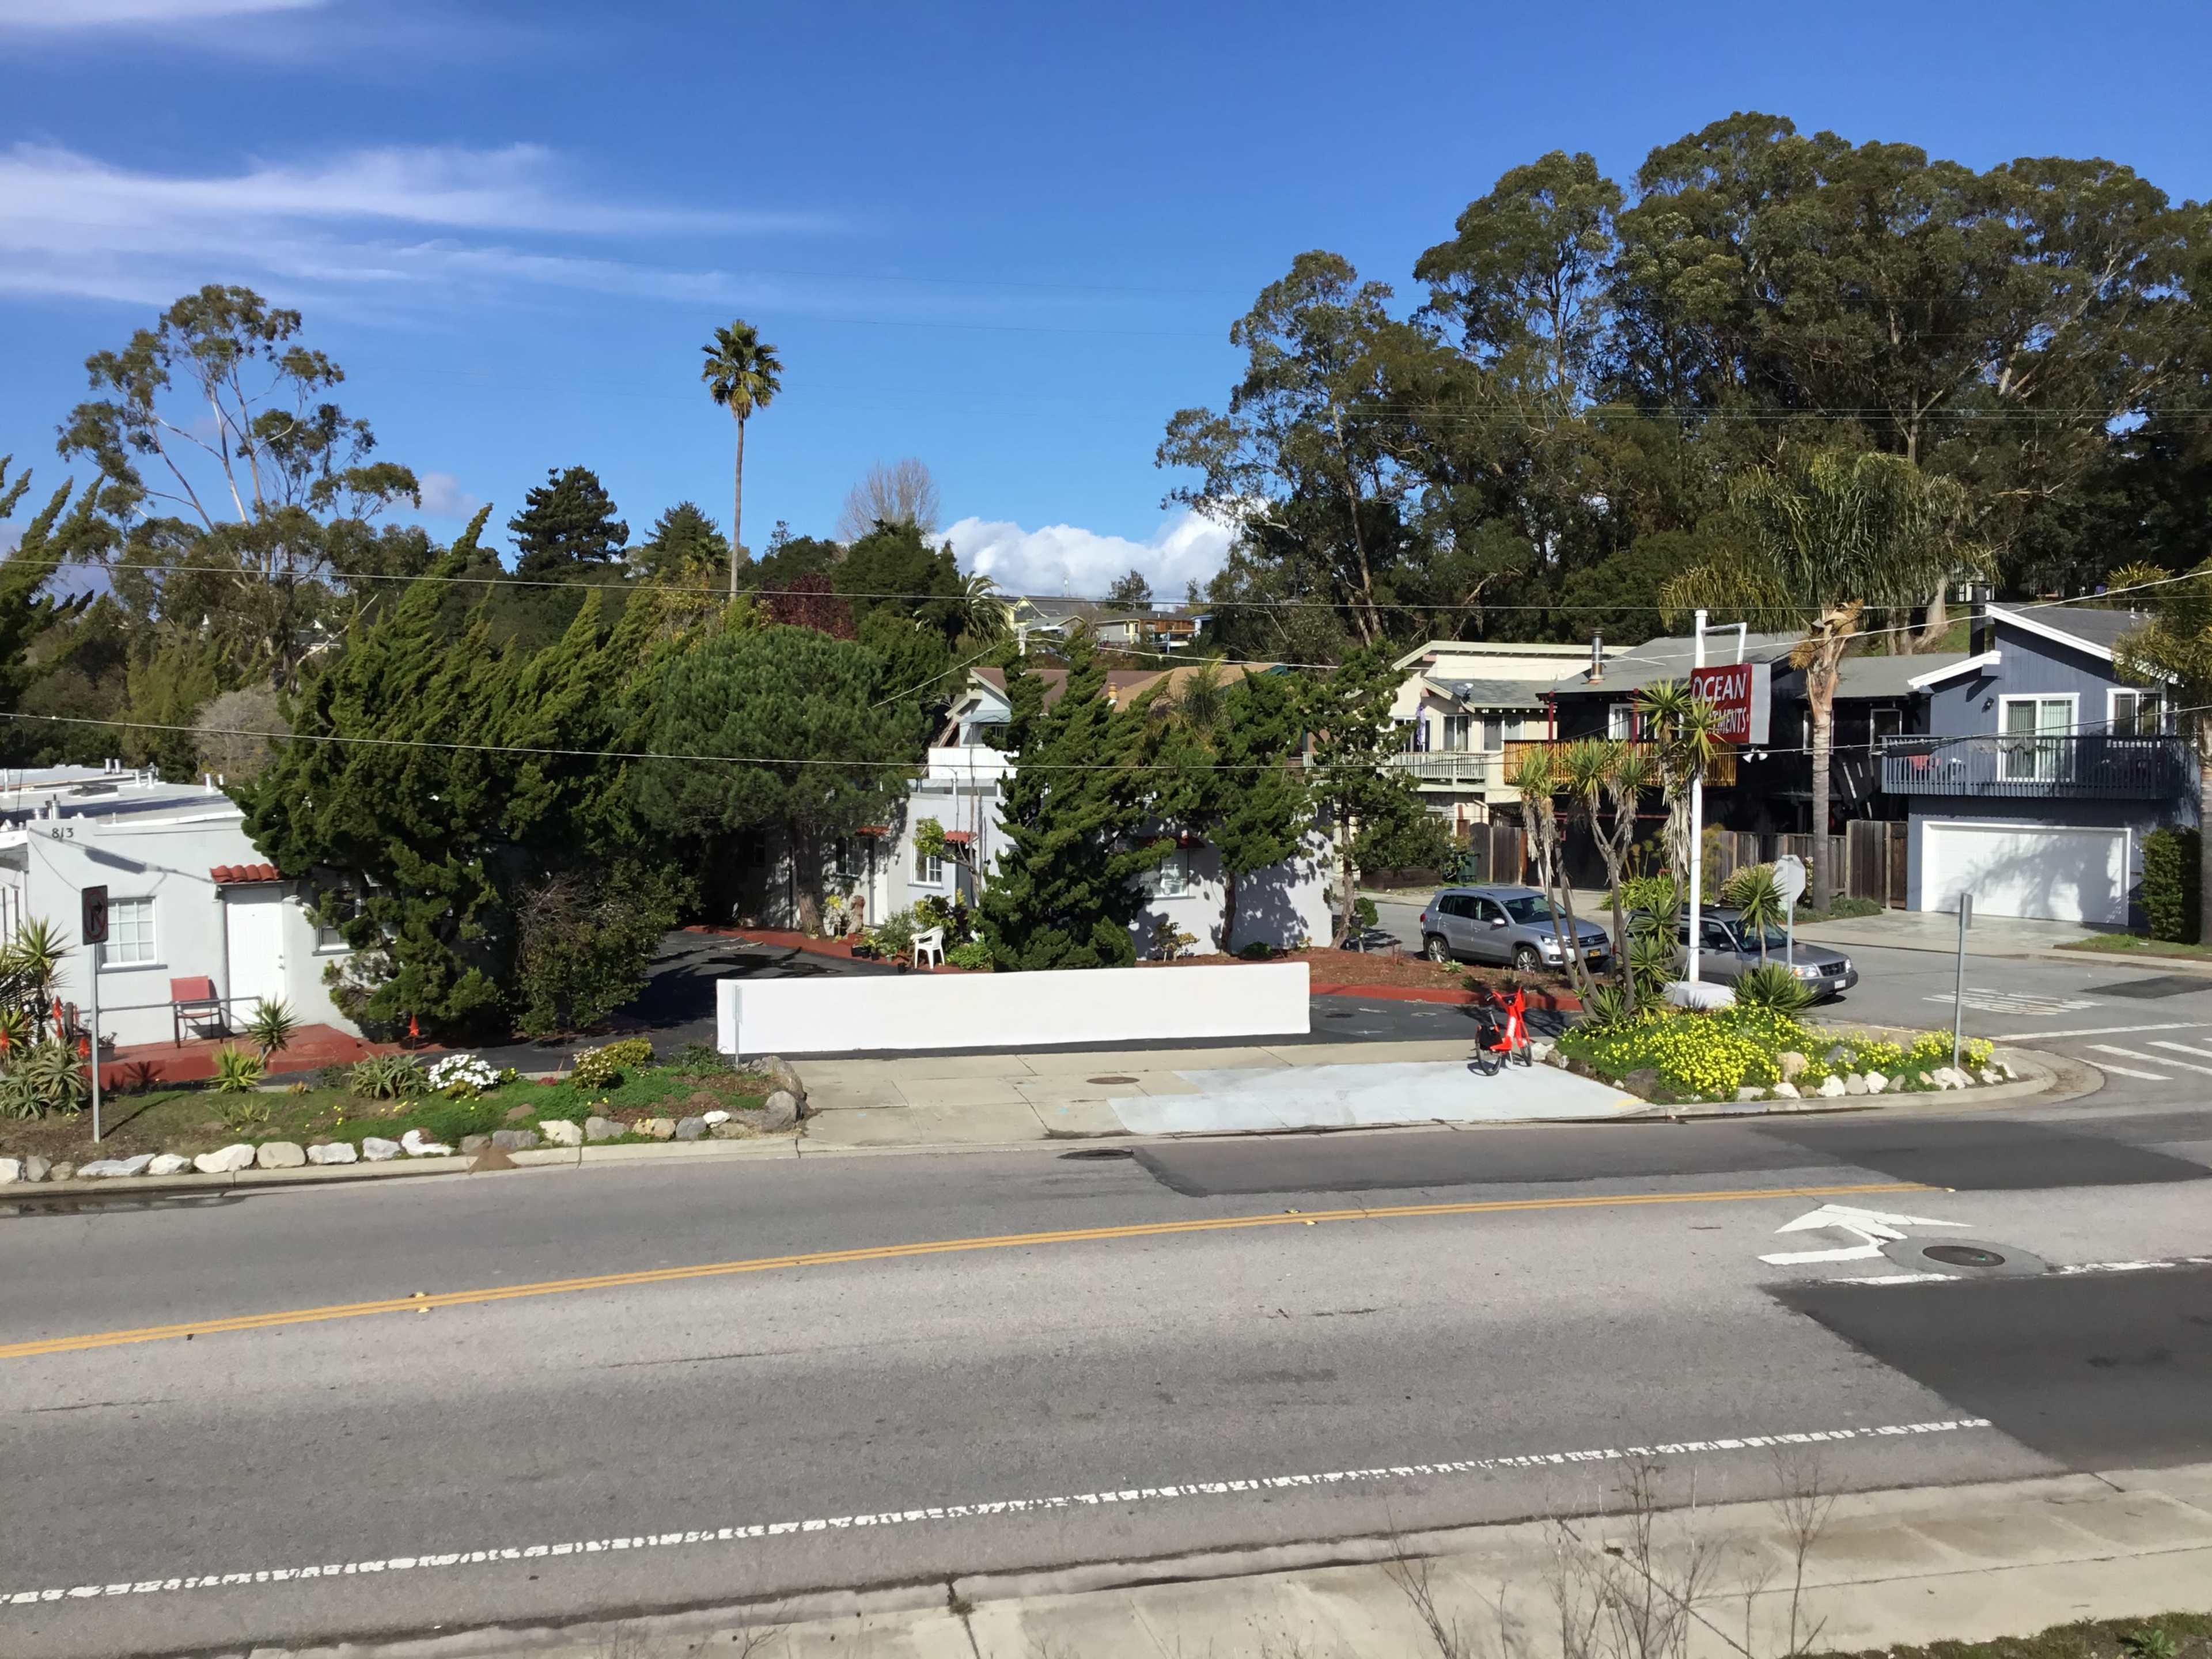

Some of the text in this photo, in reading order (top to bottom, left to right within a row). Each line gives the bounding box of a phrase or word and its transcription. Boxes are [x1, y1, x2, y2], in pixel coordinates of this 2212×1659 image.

[1692, 673, 1747, 702] OCEAN
[1703, 707, 1747, 734] TMENTS
[51, 827, 74, 838] 813
